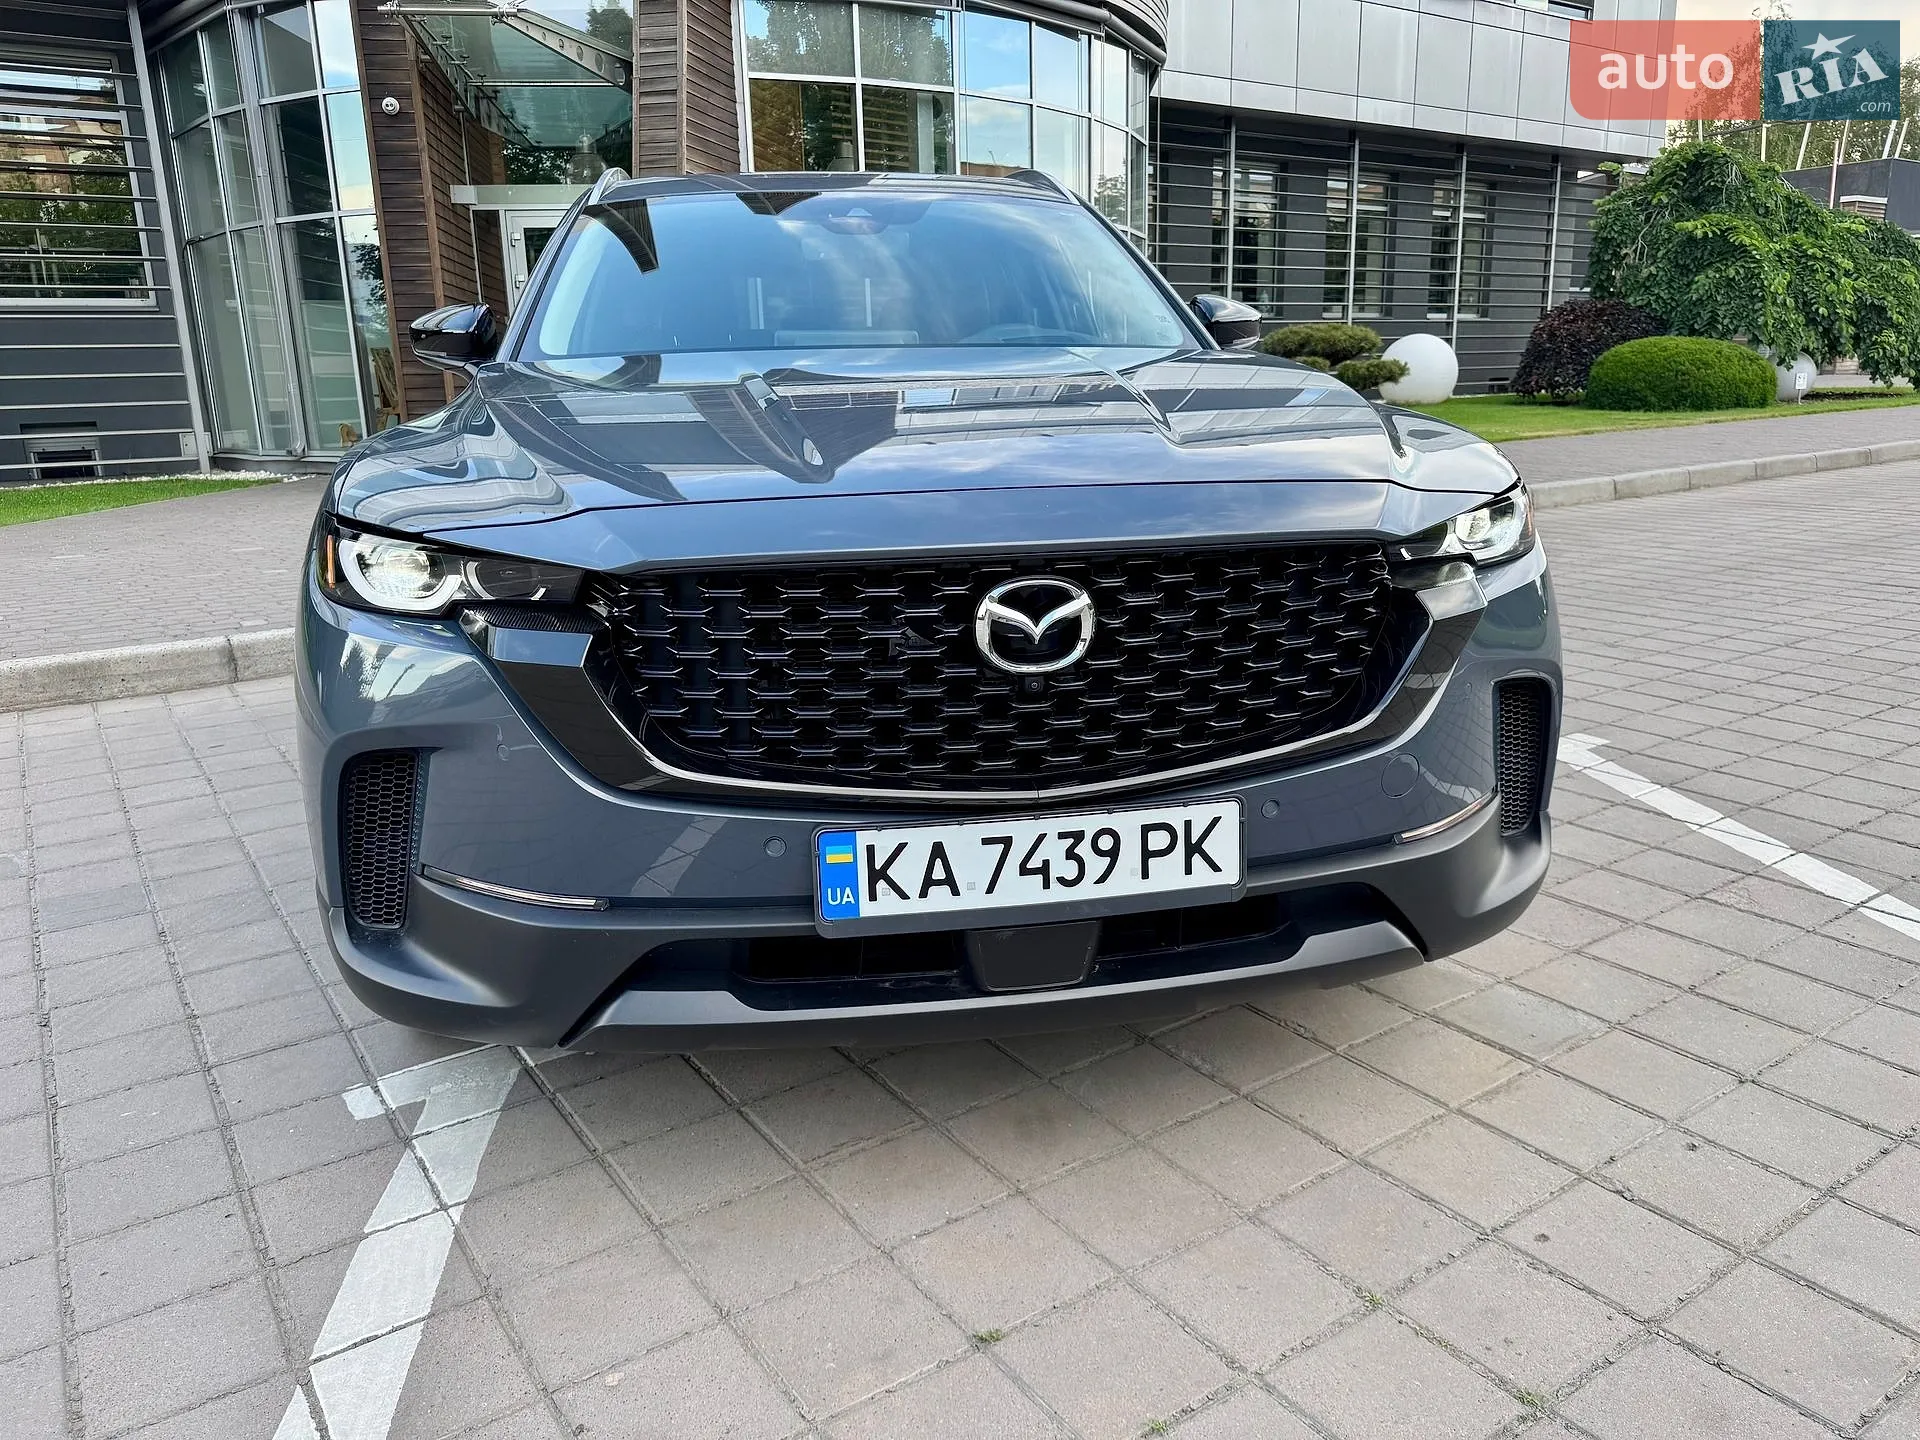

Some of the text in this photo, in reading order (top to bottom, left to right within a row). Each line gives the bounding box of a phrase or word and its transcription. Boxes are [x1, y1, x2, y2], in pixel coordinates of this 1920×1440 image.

[865, 816, 1223, 902] KA 7439 PK
[826, 886, 855, 906] UA
